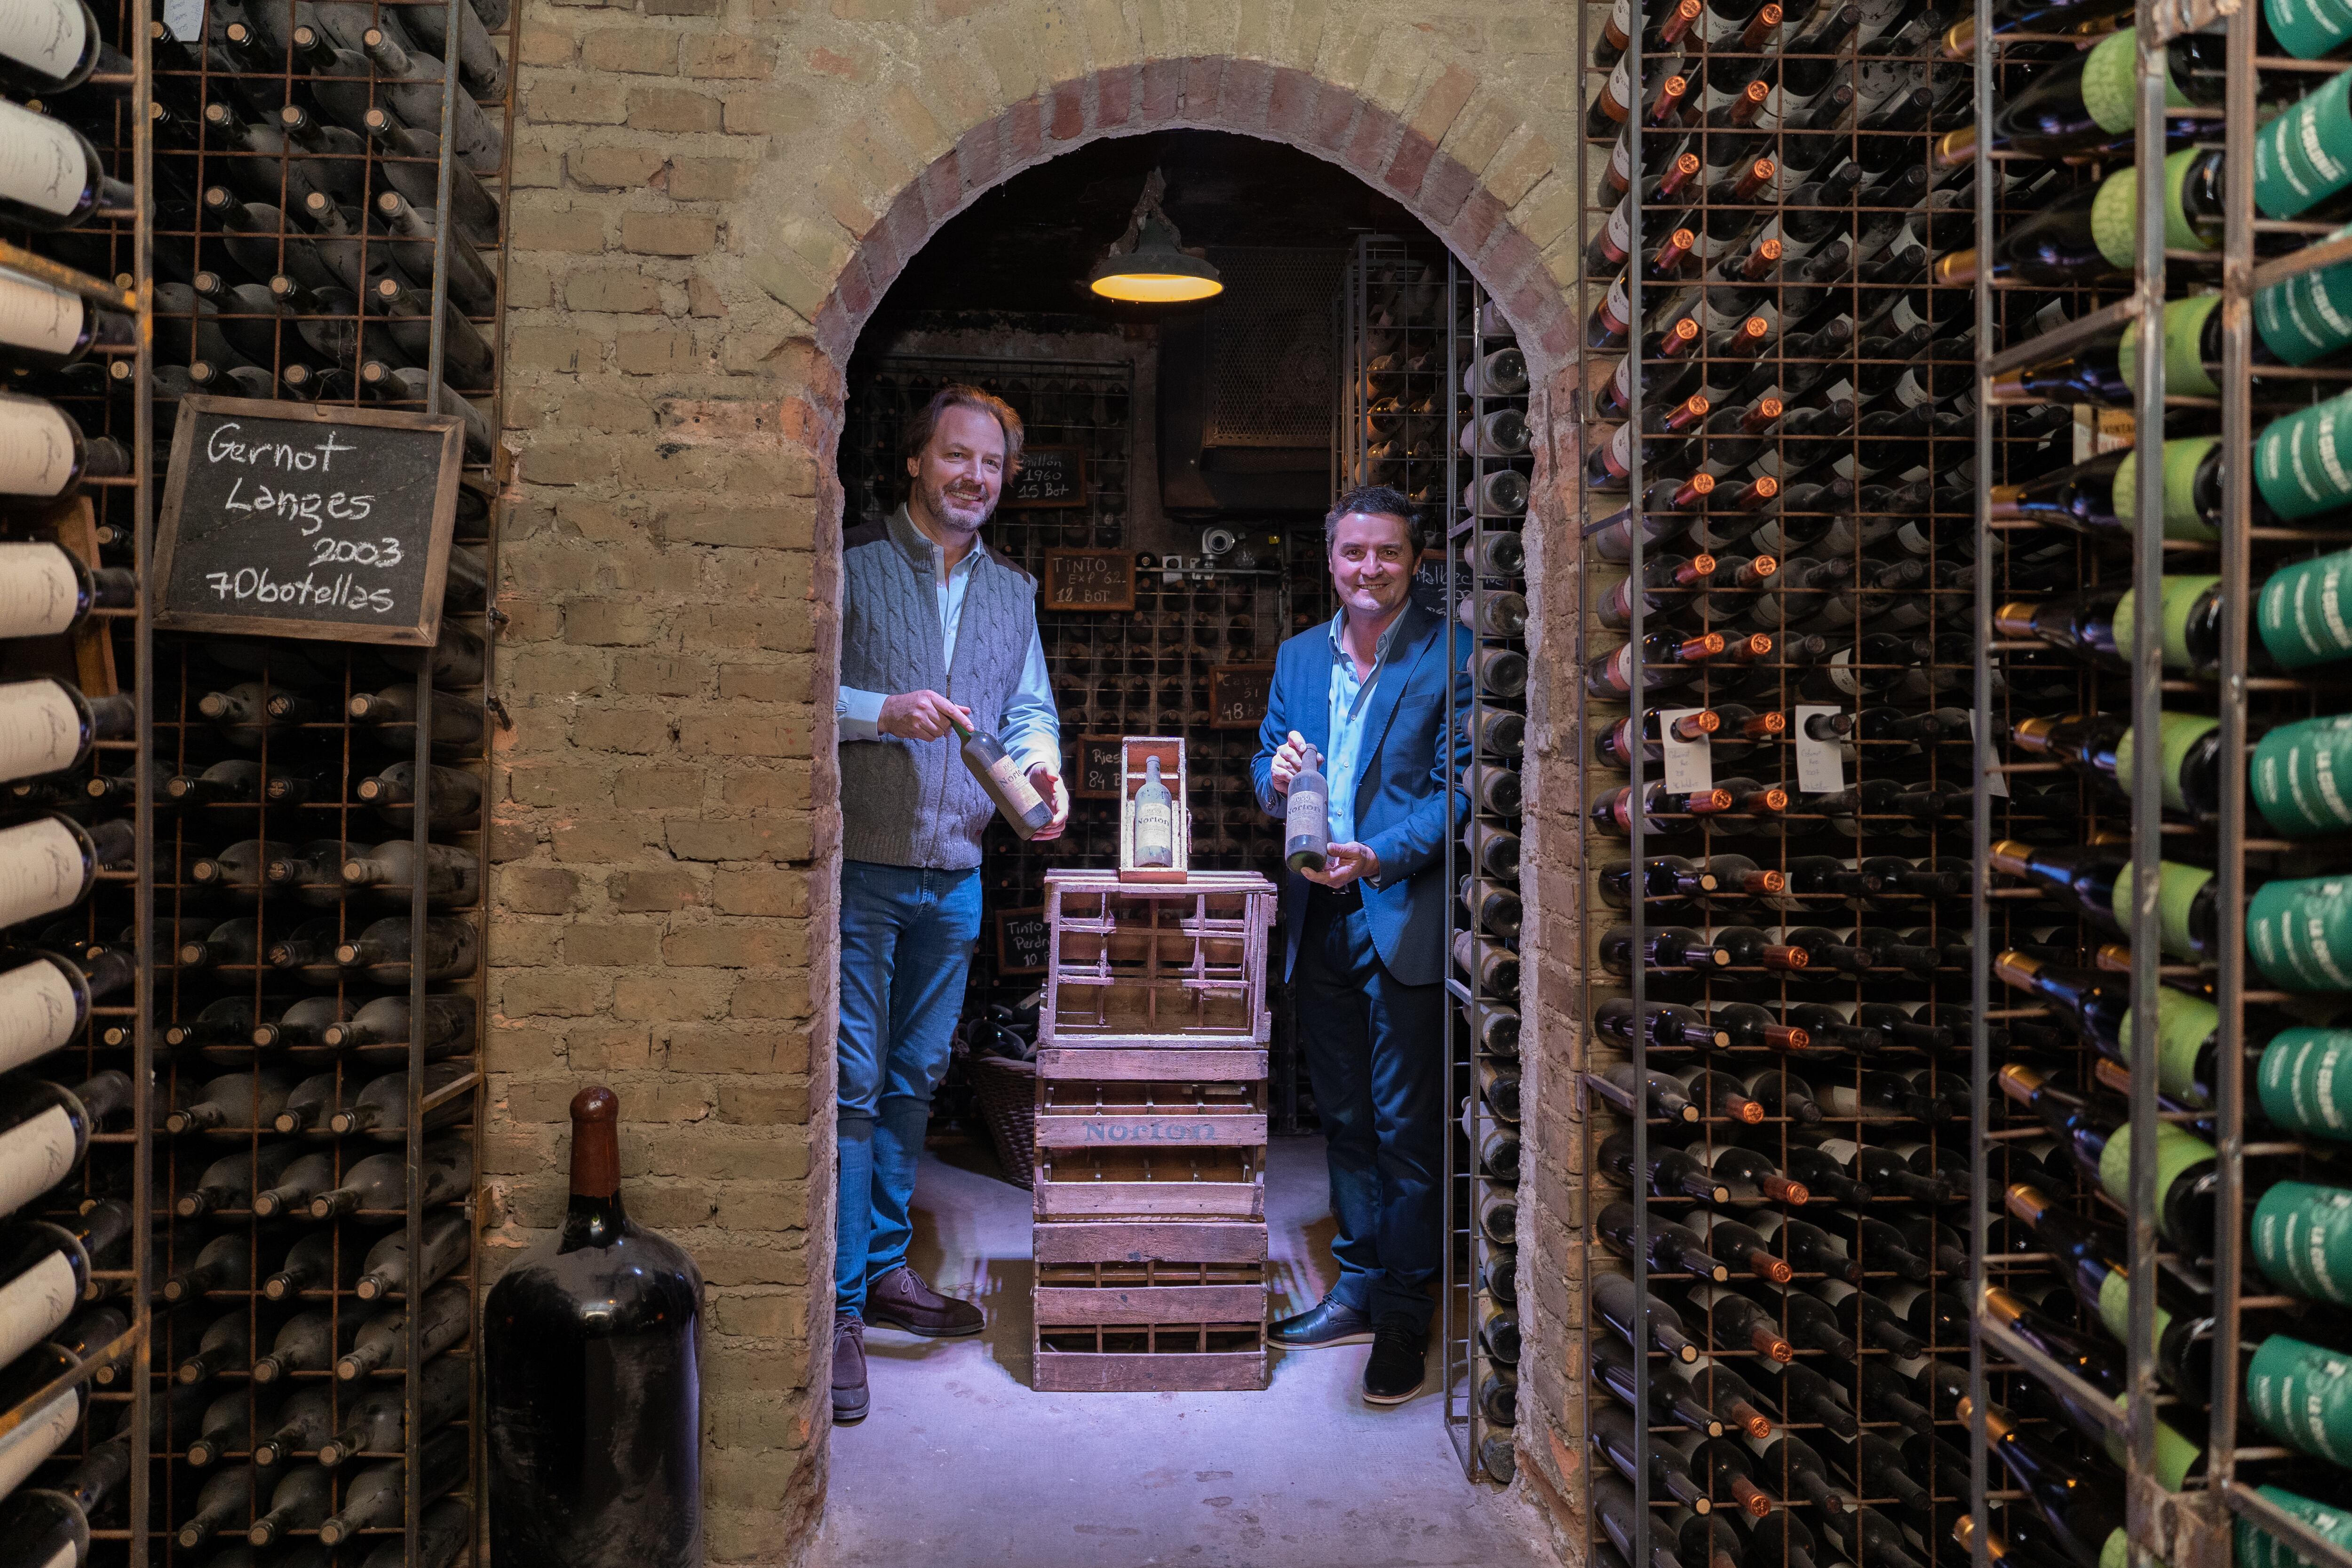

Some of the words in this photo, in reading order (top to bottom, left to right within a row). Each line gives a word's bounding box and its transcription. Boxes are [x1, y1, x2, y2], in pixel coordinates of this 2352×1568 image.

[207, 422, 357, 472] Gernot
[1024, 453, 1061, 467] millón
[1022, 469, 1062, 482] 1960
[1017, 484, 1039, 499] 15
[1045, 482, 1069, 497] Bot
[225, 477, 375, 536] Langes
[309, 537, 403, 568] 2003
[1092, 748, 1121, 765] Ries
[998, 769, 1023, 789] Norto
[1089, 770, 1105, 790] 84
[1287, 803, 1321, 815] Norton
[1137, 816, 1169, 827] Norton
[1007, 920, 1043, 935] Tinto
[1024, 953, 1038, 967] 10
[1082, 1121, 1217, 1143] Norton
